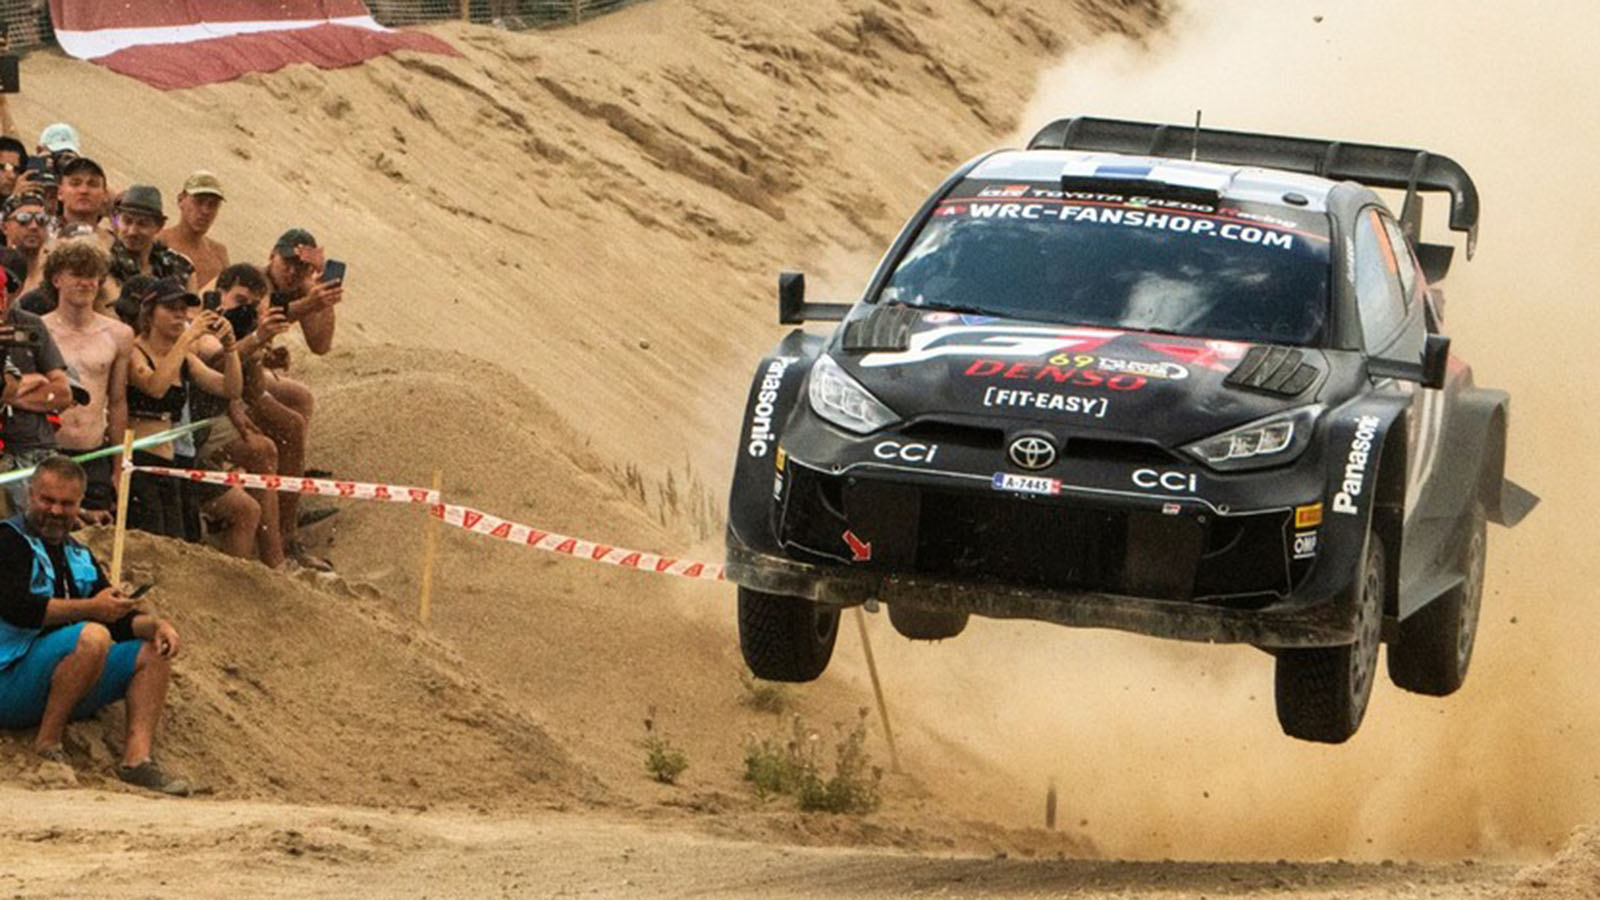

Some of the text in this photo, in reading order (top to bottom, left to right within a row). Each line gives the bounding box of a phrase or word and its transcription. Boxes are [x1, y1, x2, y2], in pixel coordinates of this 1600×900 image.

[1030, 189, 1123, 202] TOYOTA
[969, 202, 1294, 250] WRC-FANSHOP.COM
[1048, 353, 1095, 368] 69
[964, 357, 1149, 391] DENSO
[1005, 477, 1049, 492] A-7445
